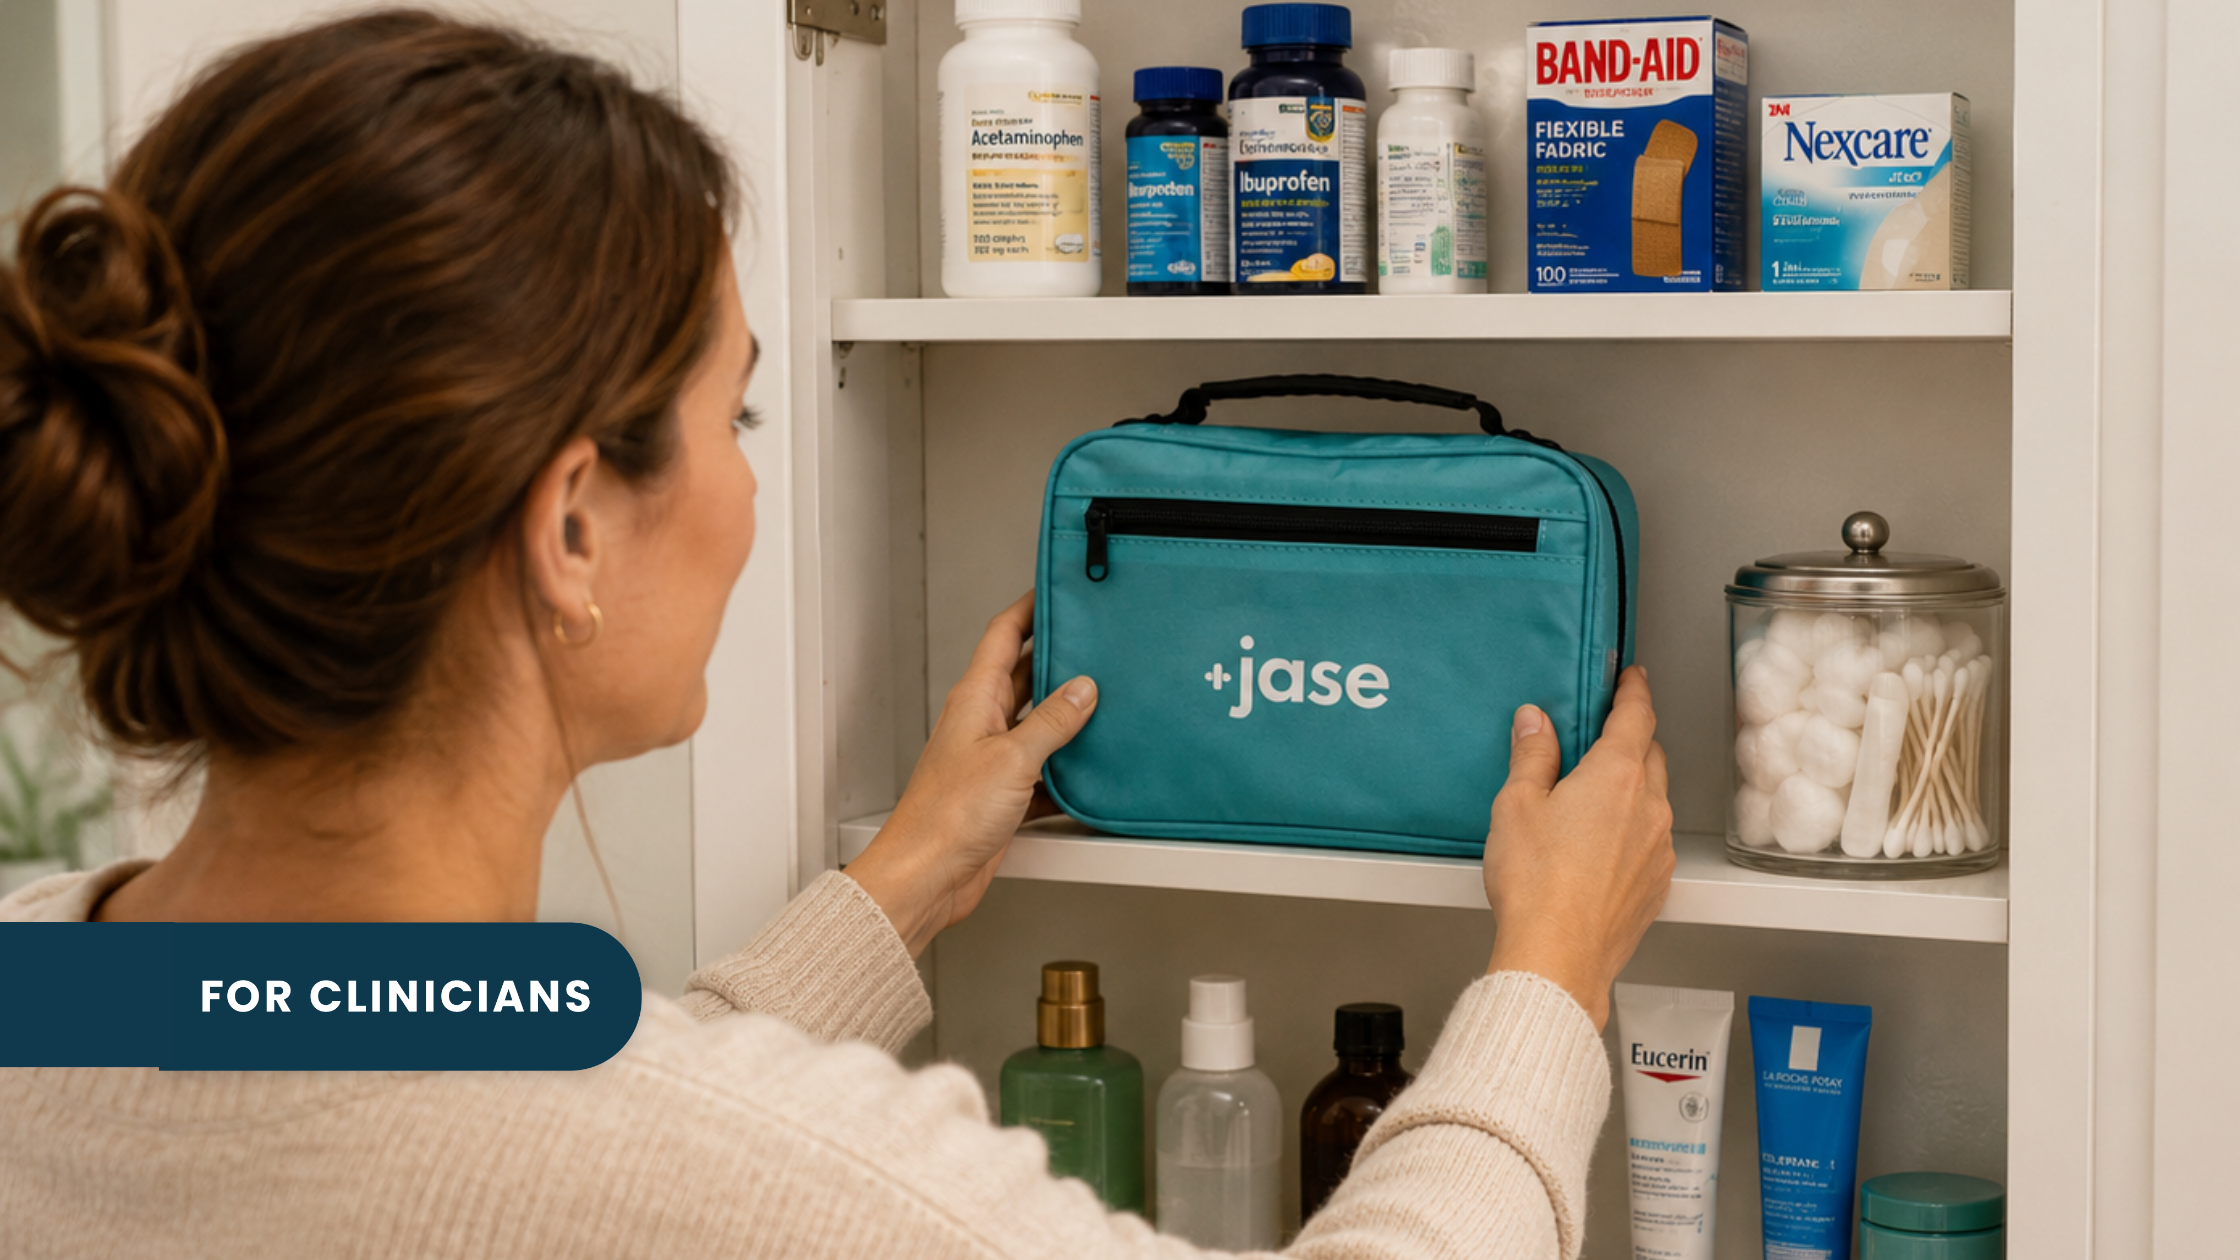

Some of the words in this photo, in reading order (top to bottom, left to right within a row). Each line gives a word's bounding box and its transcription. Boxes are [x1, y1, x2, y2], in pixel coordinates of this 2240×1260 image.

[1536, 37, 1700, 85] BAND-AID
[971, 129, 1083, 151] Acetaminophen
[1783, 120, 1929, 166] Nexcare
[1240, 169, 1330, 197] Ibuprofen
[1536, 266, 1566, 282] 100
[1631, 1042, 1708, 1071] Eucerin
